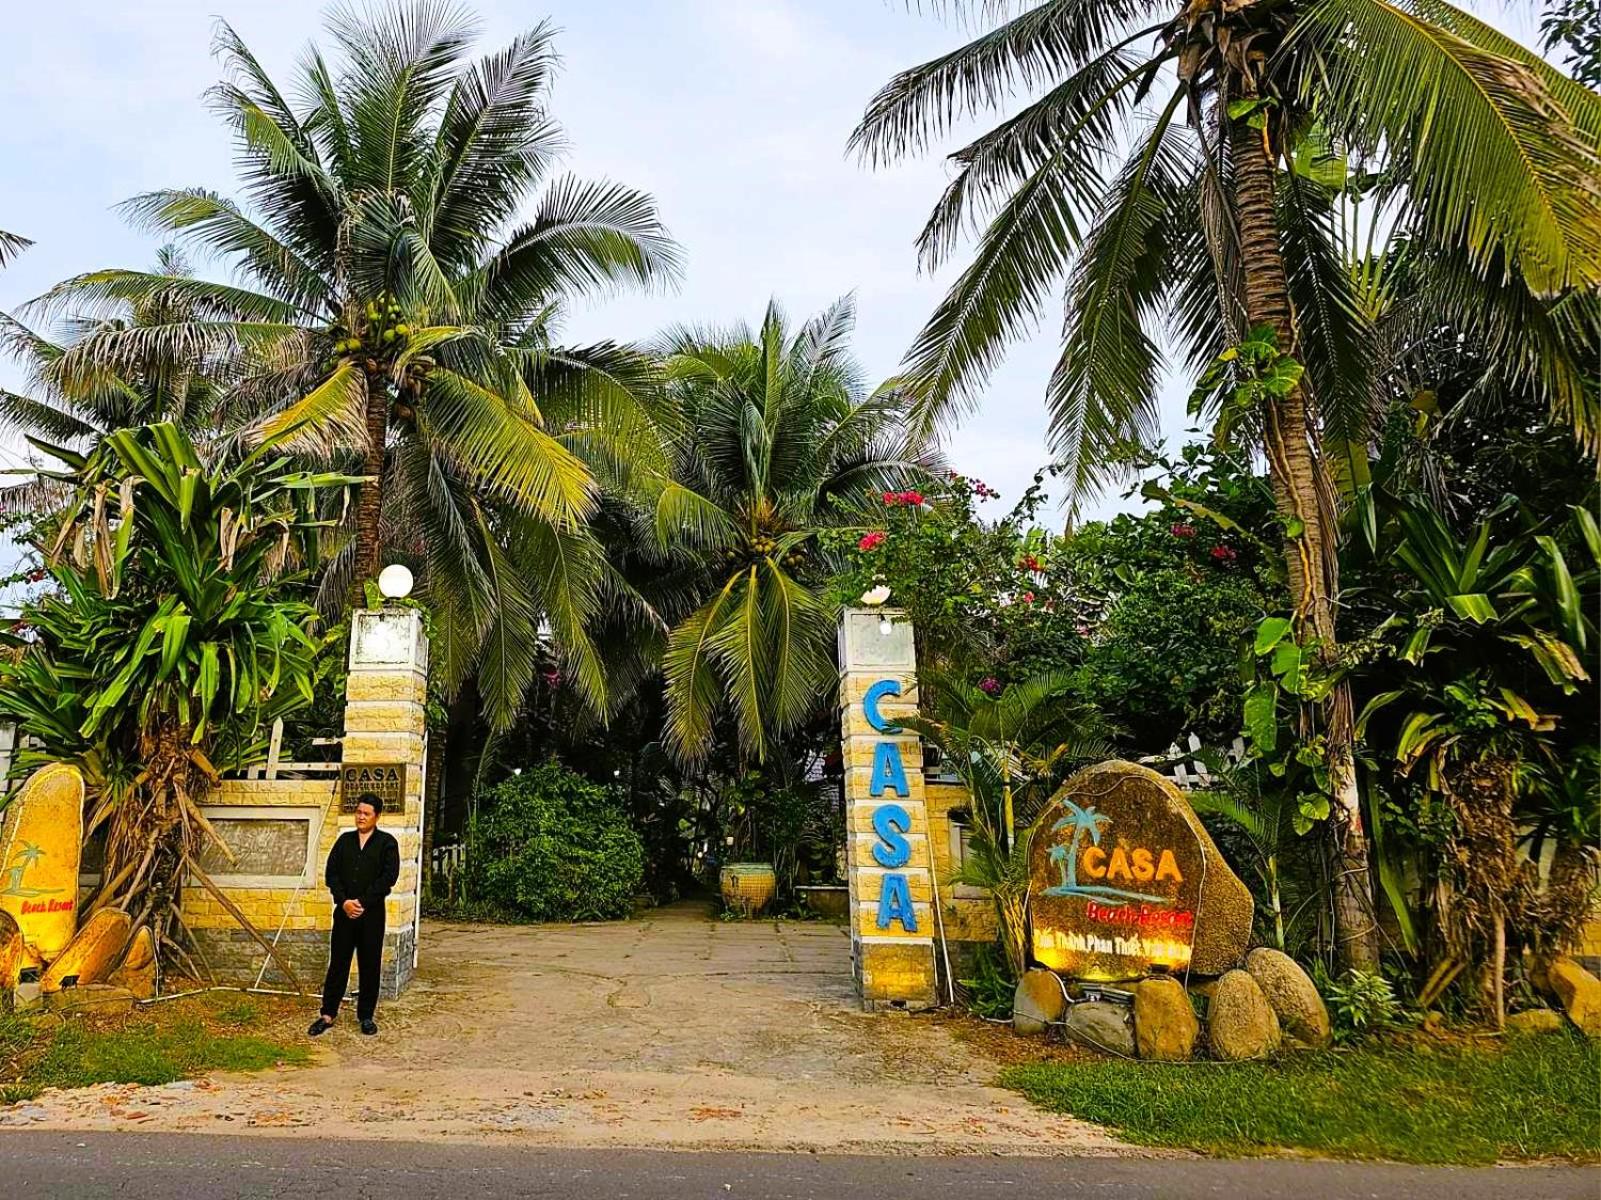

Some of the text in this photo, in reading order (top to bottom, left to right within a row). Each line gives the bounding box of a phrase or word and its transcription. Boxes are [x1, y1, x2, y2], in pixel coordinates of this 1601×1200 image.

[345, 768, 400, 781] CASA
[862, 679, 918, 932] CASA
[1083, 846, 1184, 882] CASA
